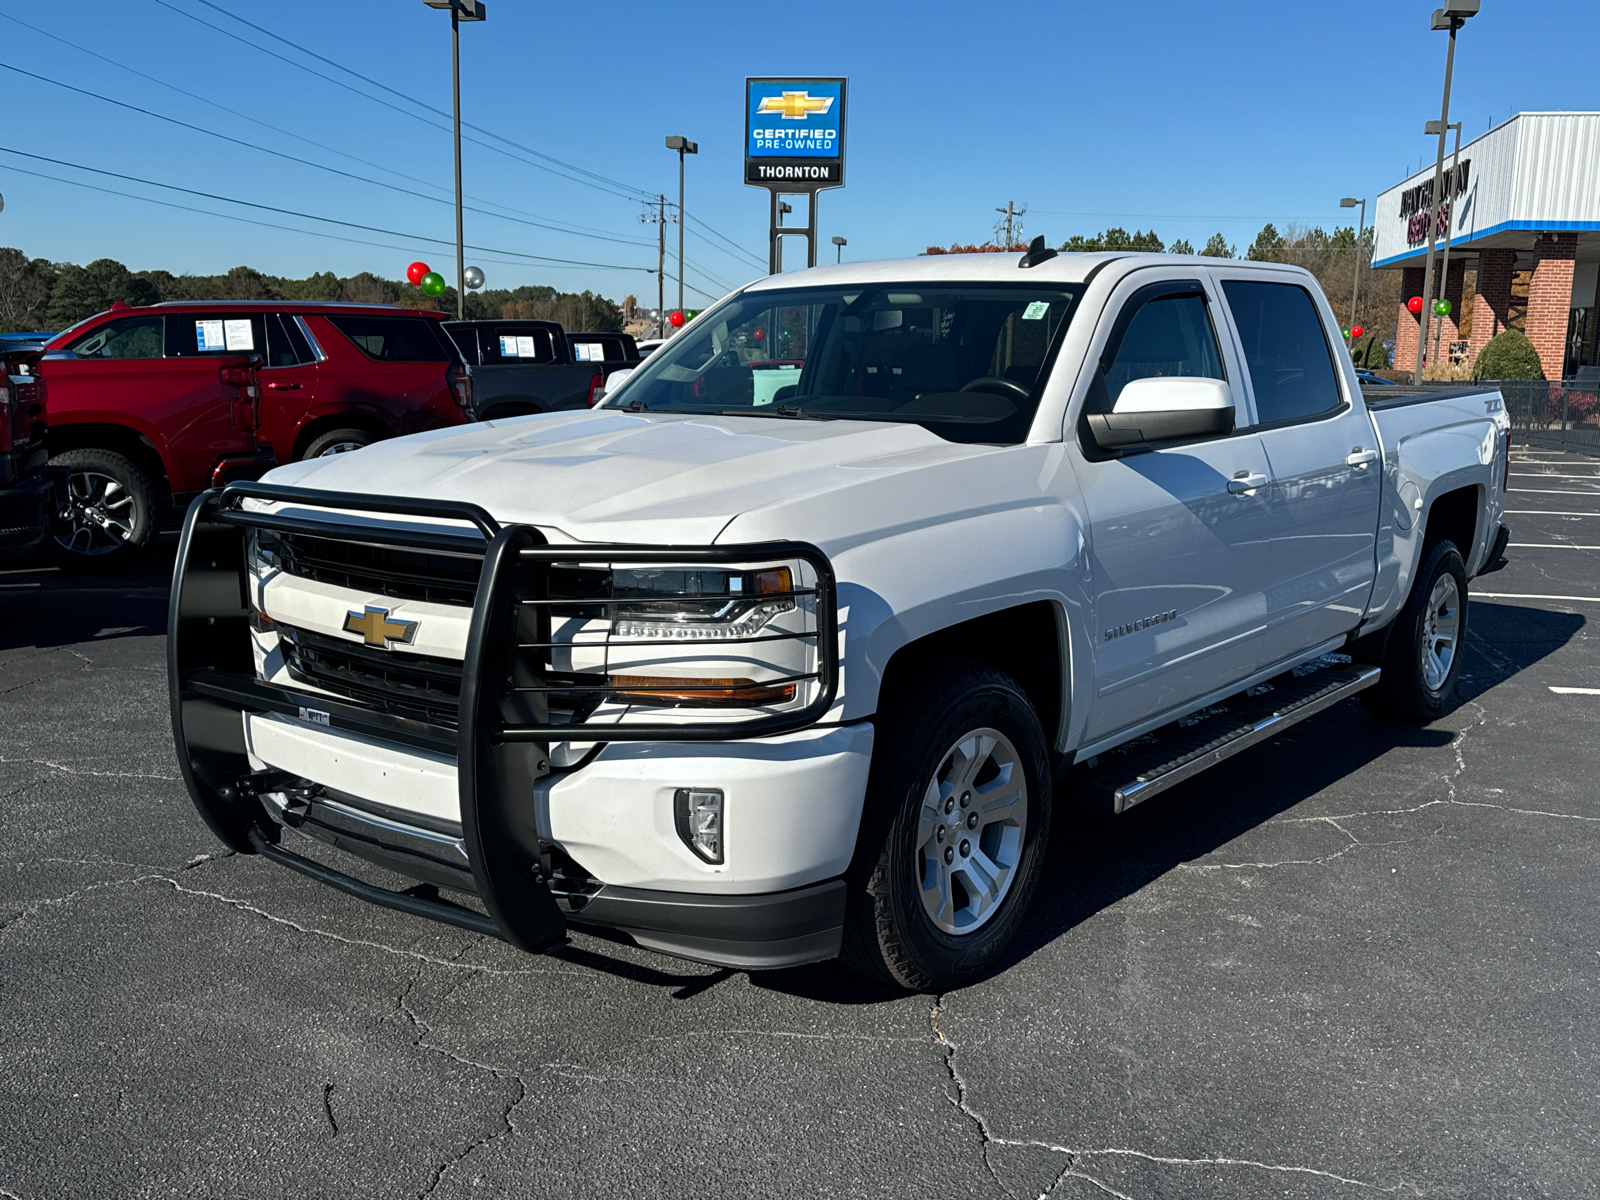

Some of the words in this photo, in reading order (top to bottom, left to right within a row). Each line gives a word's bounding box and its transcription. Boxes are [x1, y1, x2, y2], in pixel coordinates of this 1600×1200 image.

[753, 129, 836, 139] CERTIFIED
[757, 139, 832, 149] PRE-OWNED
[758, 166, 829, 179] THORNTON
[1425, 203, 1449, 238] CRS
[1104, 609, 1176, 641] SILVERADO
